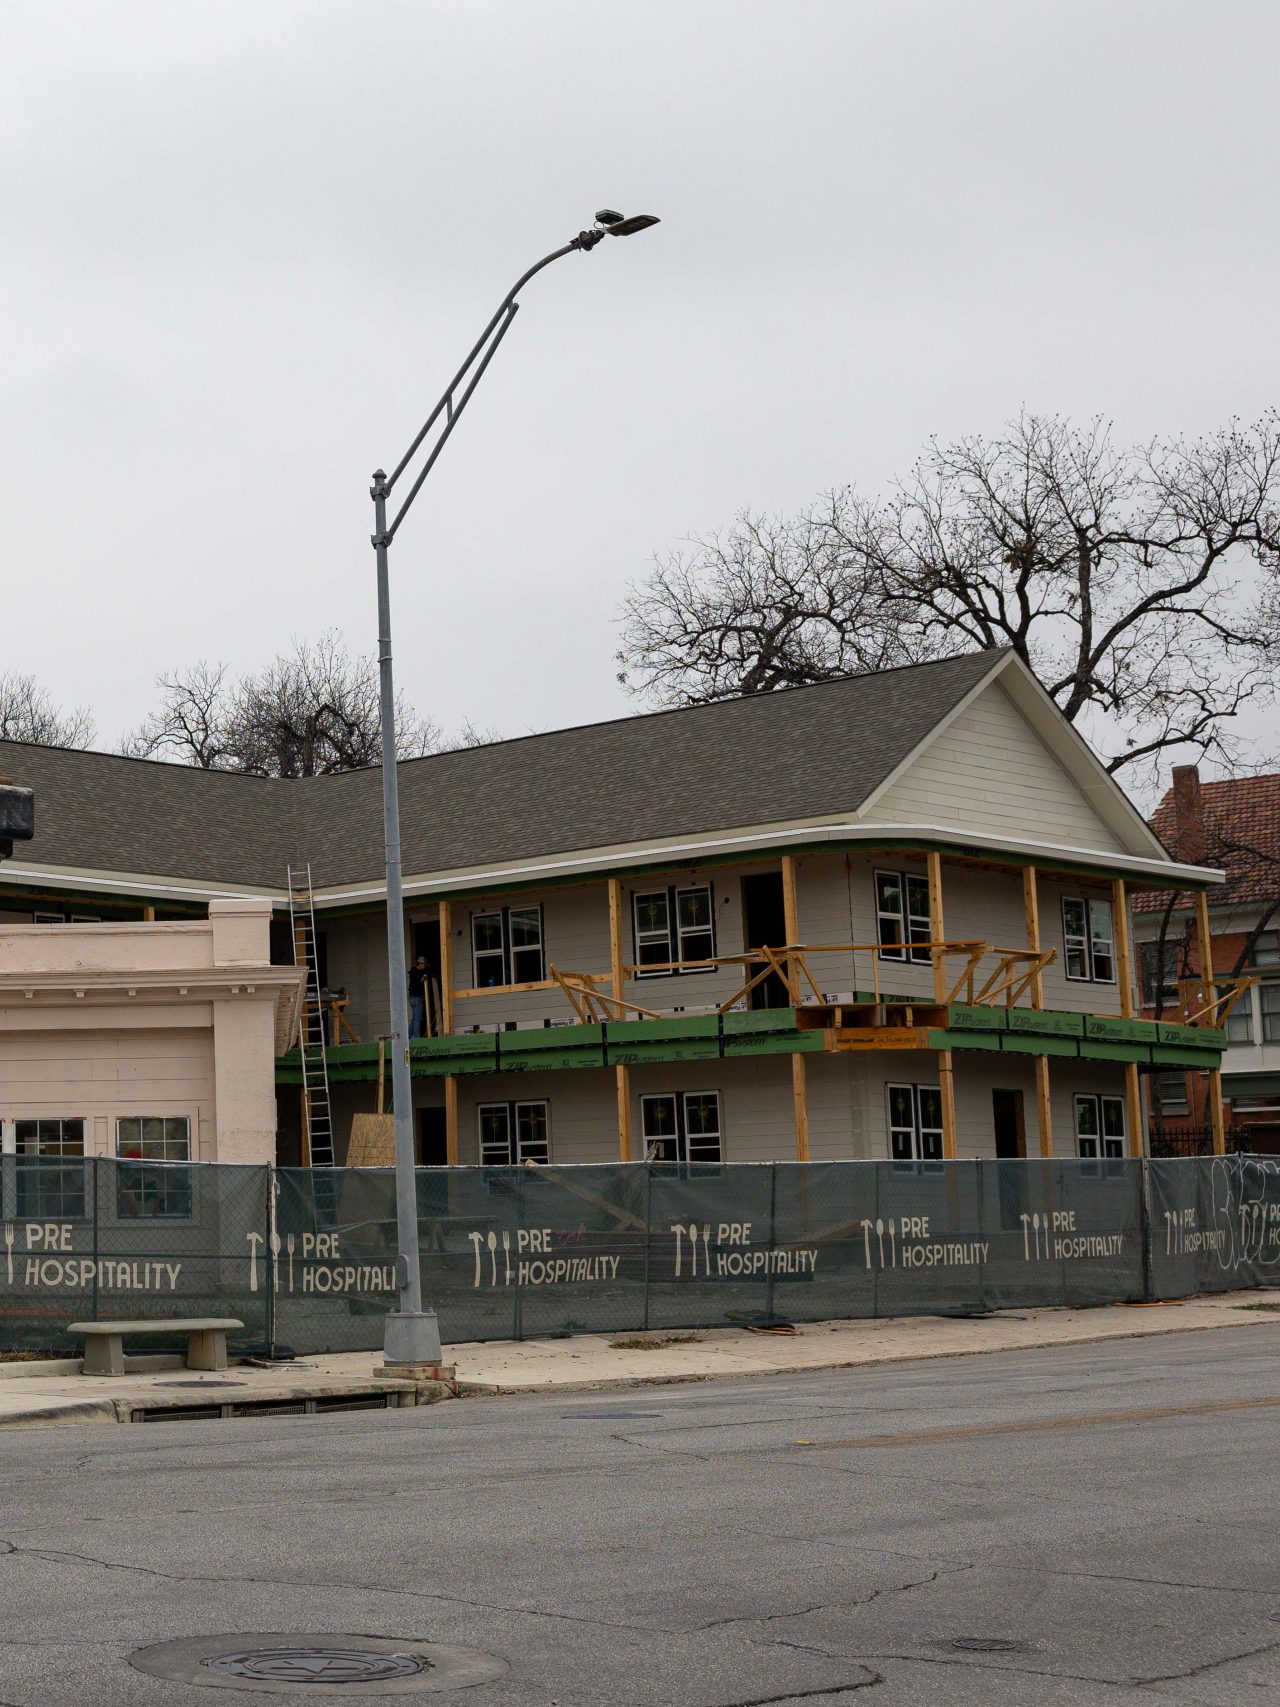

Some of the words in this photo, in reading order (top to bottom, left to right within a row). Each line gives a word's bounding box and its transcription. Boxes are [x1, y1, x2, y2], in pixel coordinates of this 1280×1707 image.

[717, 1222, 751, 1245] PRE
[901, 1217, 930, 1239] PRE
[1052, 1211, 1077, 1232] PRE
[26, 1224, 72, 1251] PRE
[302, 1233, 339, 1259] PRE
[517, 1228, 553, 1254] PRE
[1053, 1234, 1124, 1259] HOSPITALITY
[717, 1250, 817, 1276] HOSPITALITY
[902, 1241, 989, 1267] HOSPITALITY
[25, 1260, 182, 1291] HOSPITALITY
[302, 1266, 397, 1292] HOSPITALI
[518, 1256, 620, 1286] HOSPITALITY
